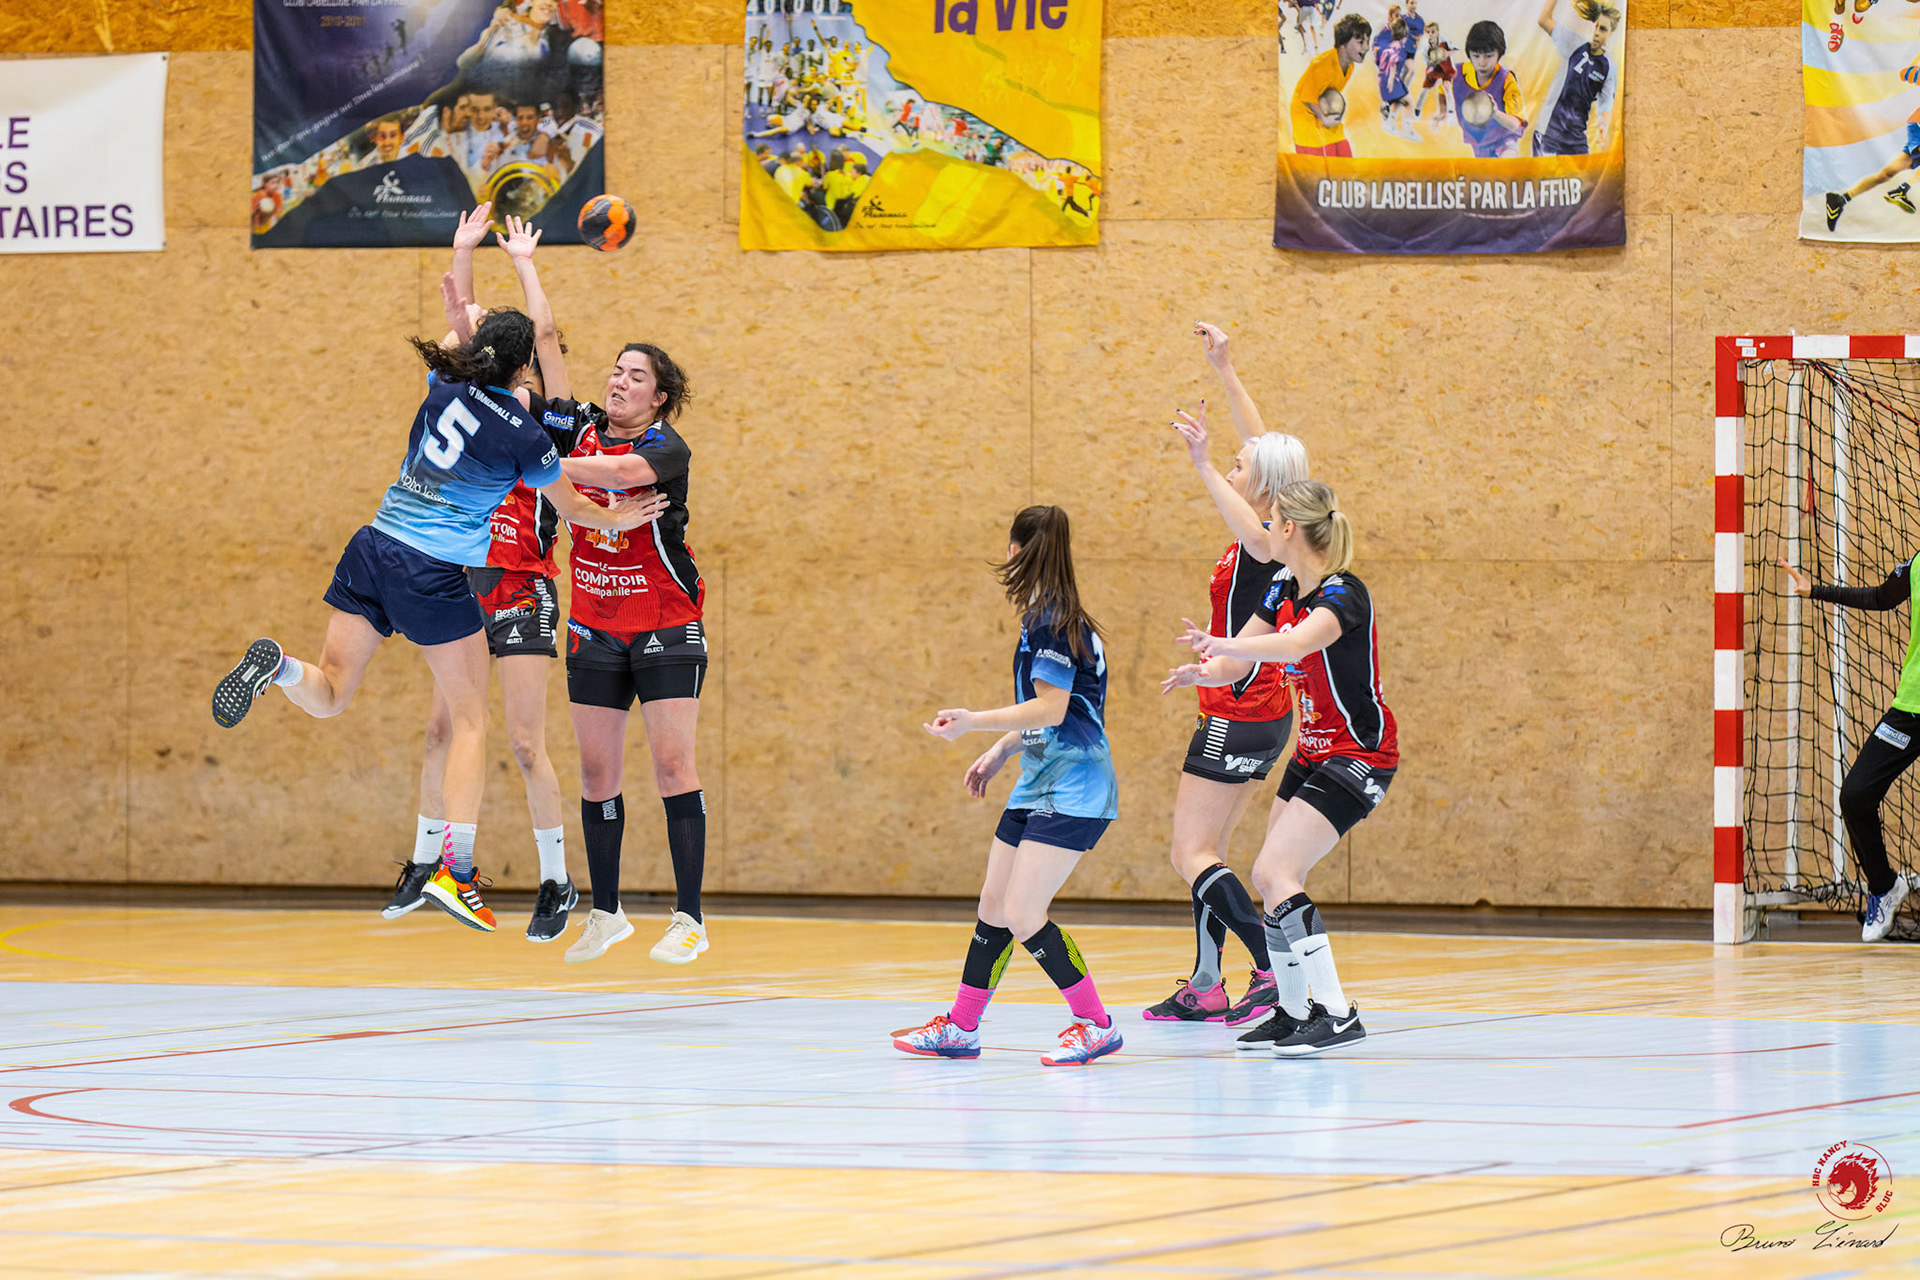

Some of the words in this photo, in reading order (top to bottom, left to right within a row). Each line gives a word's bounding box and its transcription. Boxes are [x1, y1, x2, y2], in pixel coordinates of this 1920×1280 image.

[934, 0, 978, 35] la
[1318, 179, 1366, 209] CLUB
[1371, 176, 1467, 210] LABELLISÉ
[1470, 181, 1507, 209] PAR
[1512, 181, 1536, 209] LA
[1540, 178, 1582, 208] FFHB
[509, 415, 523, 428] 52
[424, 397, 482, 470] 5
[599, 562, 608, 572] LE
[575, 567, 648, 587] COMPTOIR
[585, 584, 631, 598] Campanile
[643, 646, 665, 655] SELECT
